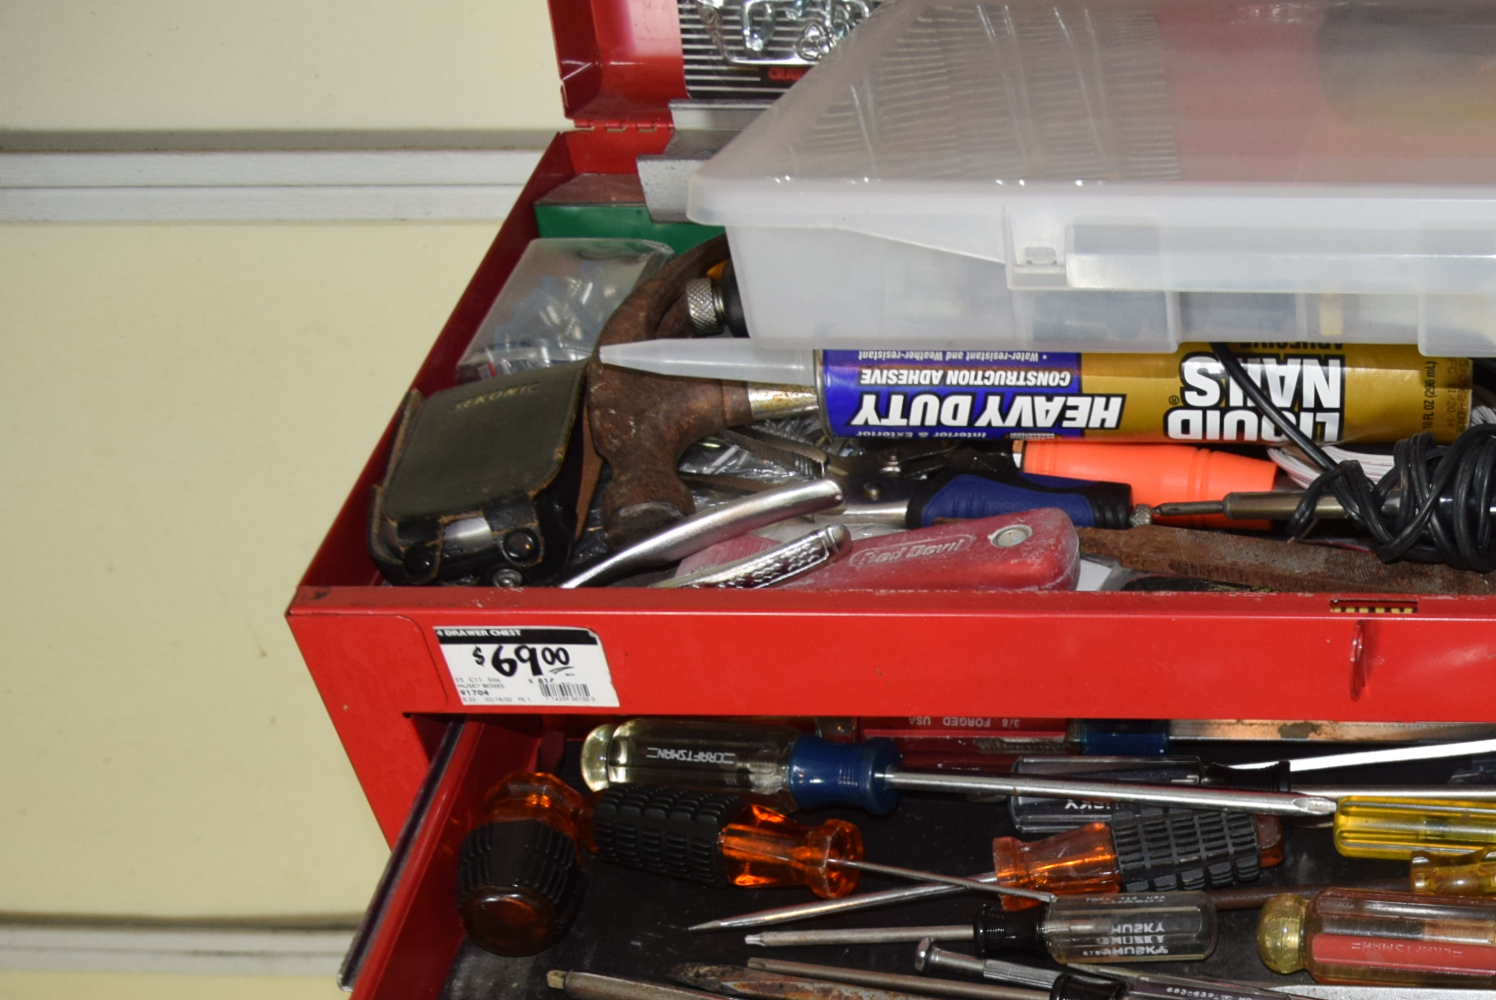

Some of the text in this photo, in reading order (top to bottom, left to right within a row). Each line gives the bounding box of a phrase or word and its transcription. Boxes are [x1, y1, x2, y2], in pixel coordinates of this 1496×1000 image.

[860, 368, 1071, 387] CONSTRUCTION ADHESIVE
[850, 392, 1124, 429] HEAVY DUTY
[1423, 399, 1436, 411] OZ
[1167, 408, 1341, 443] LIQUID
[445, 629, 489, 637] DRAWER
[490, 629, 522, 637] CHEST
[942, 716, 992, 727] FORGED
[652, 747, 731, 764] CRAFTSMAN
